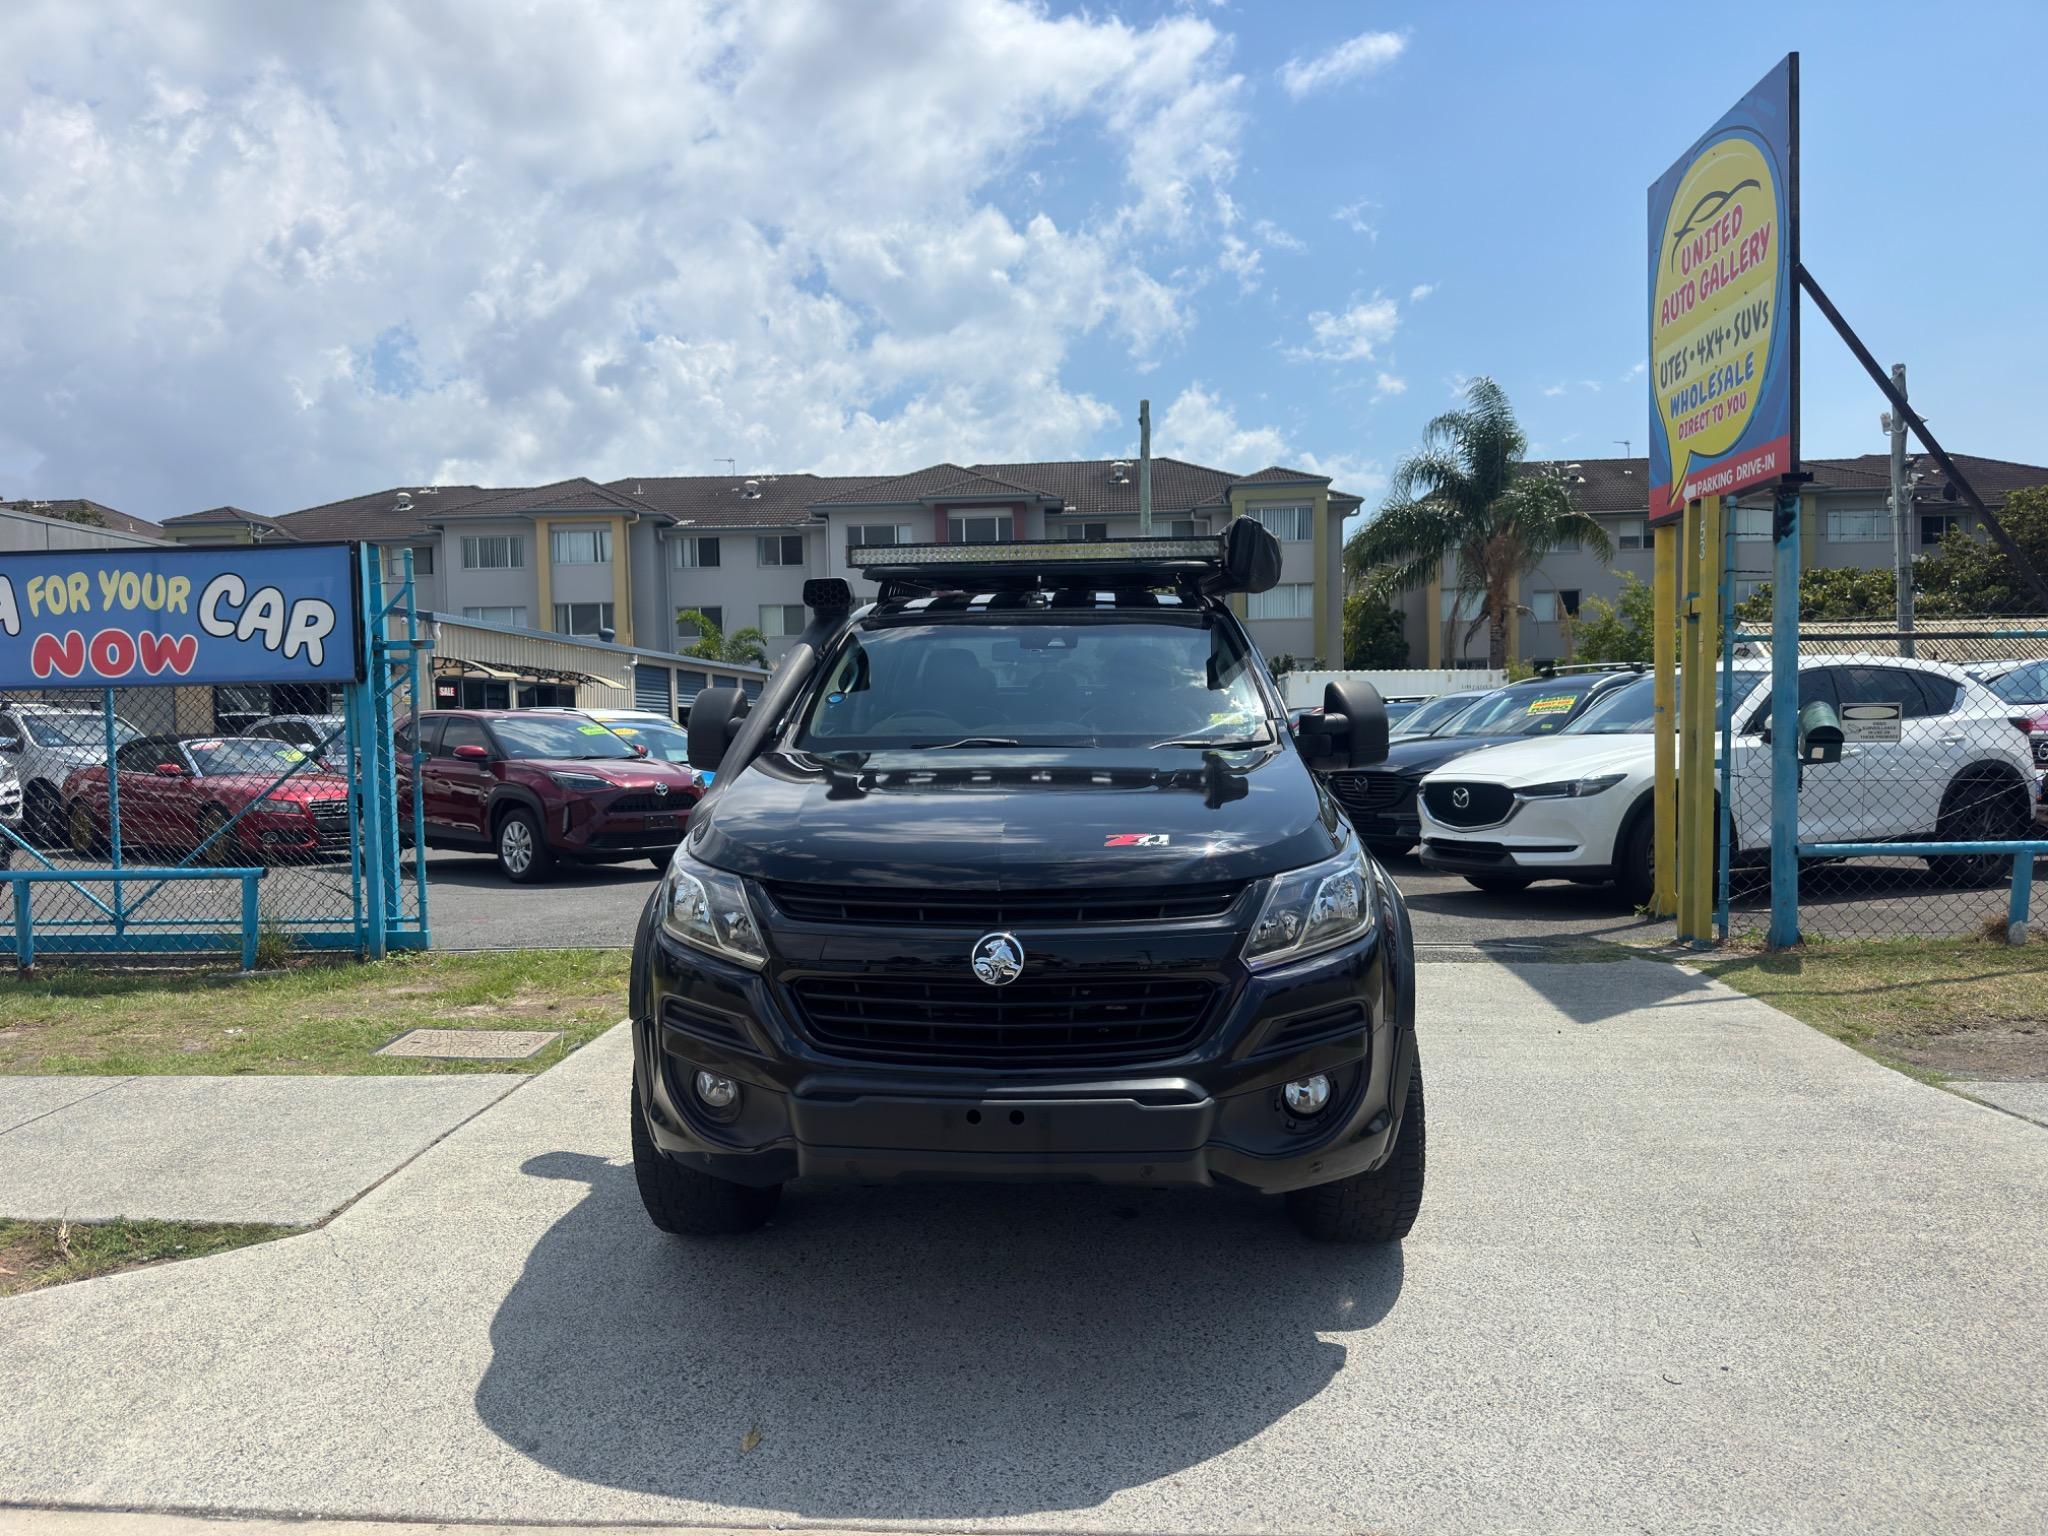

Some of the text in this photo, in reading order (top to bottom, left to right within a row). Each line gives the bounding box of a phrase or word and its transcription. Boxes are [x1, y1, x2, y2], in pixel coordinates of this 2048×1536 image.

[1681, 204, 1743, 276] UNITED
[1661, 221, 1770, 328] AUTO GALLERY
[1660, 346, 1688, 390] UTES
[1670, 351, 1754, 419] WHOLESALE
[1678, 391, 1747, 441] DIRECT TO YOU
[1697, 452, 1775, 496] PARKING DRIVE-IN
[27, 572, 90, 618] FOR
[98, 569, 191, 614] YOUR
[196, 572, 336, 667] CAR
[30, 628, 199, 679] NOW
[439, 686, 455, 697] SALE
